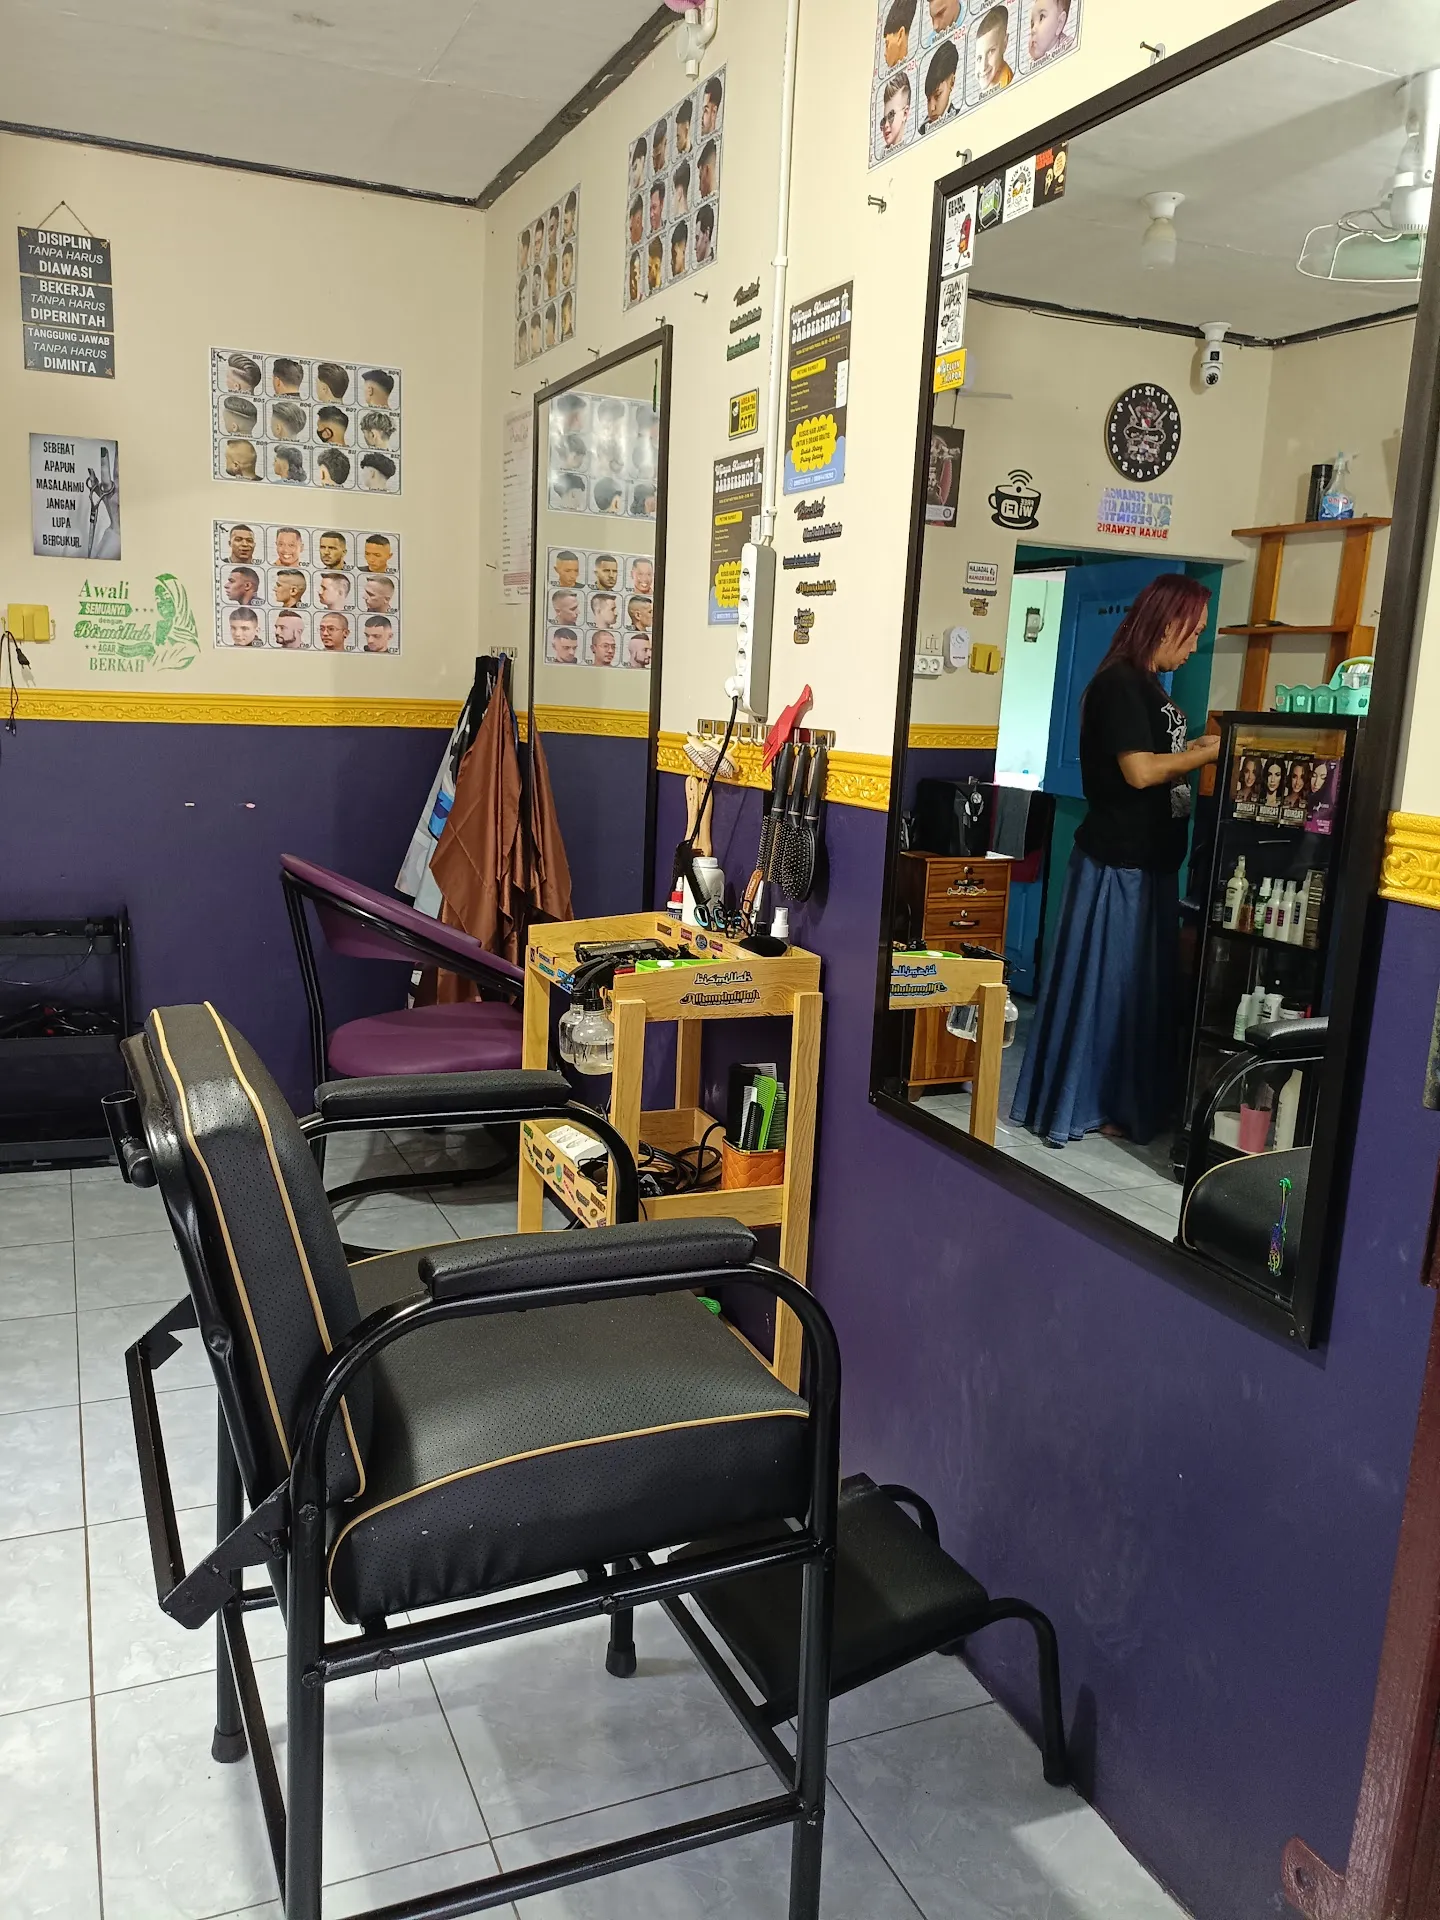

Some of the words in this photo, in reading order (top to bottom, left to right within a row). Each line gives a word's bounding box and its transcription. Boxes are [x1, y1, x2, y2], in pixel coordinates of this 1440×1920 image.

[948, 195, 964, 210] ELVIN
[948, 203, 966, 218] VAPOR
[38, 231, 91, 250] DISIPLIN
[28, 245, 63, 258] TANPA
[66, 251, 103, 264] HARUS
[39, 260, 93, 278] DIAWASI
[40, 281, 95, 299] BEKERJA
[31, 294, 66, 307] TANPA
[69, 299, 105, 312] HARUS
[31, 308, 105, 328] DIPERINTAH
[791, 311, 841, 344] BARBERSHOP
[28, 328, 77, 343] TANGGUNG
[79, 334, 110, 346] JAWAB
[33, 342, 68, 355] TANPA
[71, 347, 107, 359] HARUS
[44, 357, 96, 373] DIMINTA
[740, 413, 756, 430] CCTV
[43, 442, 75, 456] SEBERAT
[44, 460, 75, 473] APAPUN
[36, 478, 84, 492] MASALAHMU
[715, 471, 754, 493] BARBERSHOP
[46, 497, 76, 511] JANGAN
[52, 517, 71, 528] LUPA
[78, 578, 130, 600] Awali
[84, 603, 127, 616] SEMUANYA
[98, 617, 123, 626] dengan
[74, 620, 151, 641] Bismillah
[98, 644, 116, 653] AGAR
[90, 657, 145, 673] BERKAH
